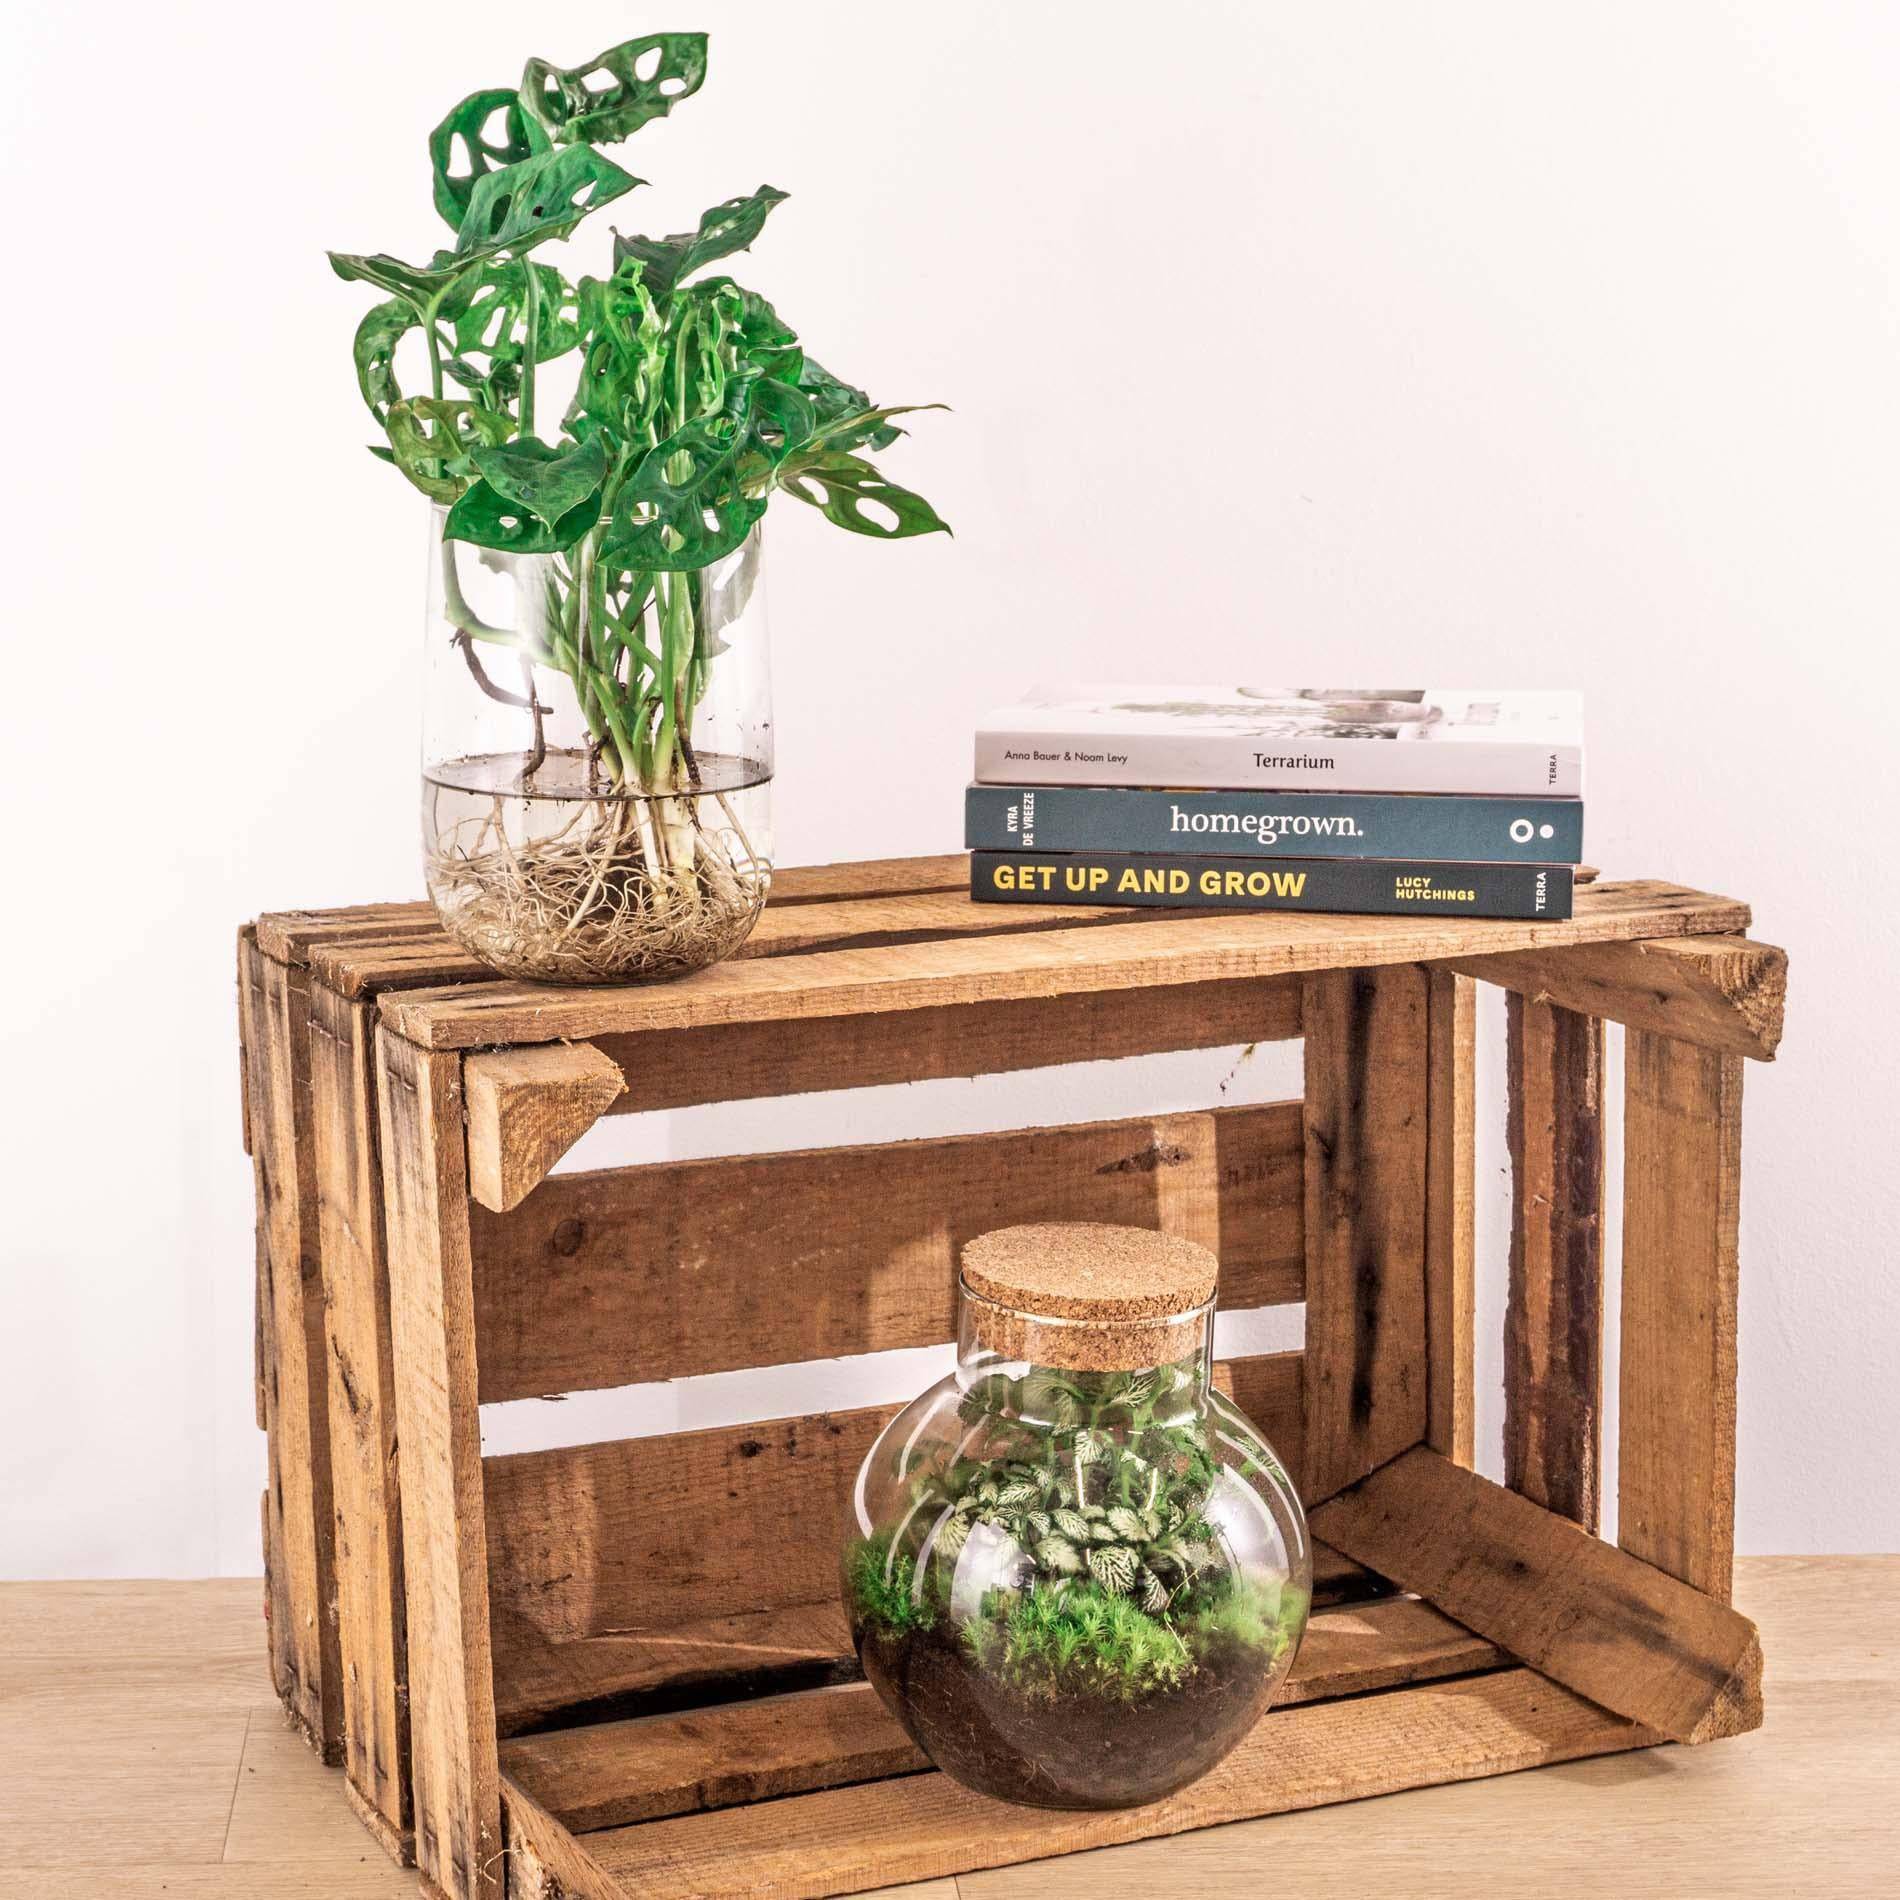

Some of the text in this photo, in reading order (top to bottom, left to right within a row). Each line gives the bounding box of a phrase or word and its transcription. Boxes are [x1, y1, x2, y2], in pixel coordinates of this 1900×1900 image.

[1004, 750, 1128, 765] Anna Bauer & Noam Levy
[1253, 753, 1335, 769] Terrarium
[1549, 754, 1557, 785] TERRA
[1007, 806, 1018, 832] KYRA
[1023, 792, 1034, 846] DE VREEZE
[1170, 805, 1364, 845] homegrown.
[993, 866, 1306, 897] GET UP AND GROW
[1396, 877, 1431, 889] LUCY
[1396, 889, 1475, 901] HUTCHINGS
[1536, 872, 1547, 911] TERRA
